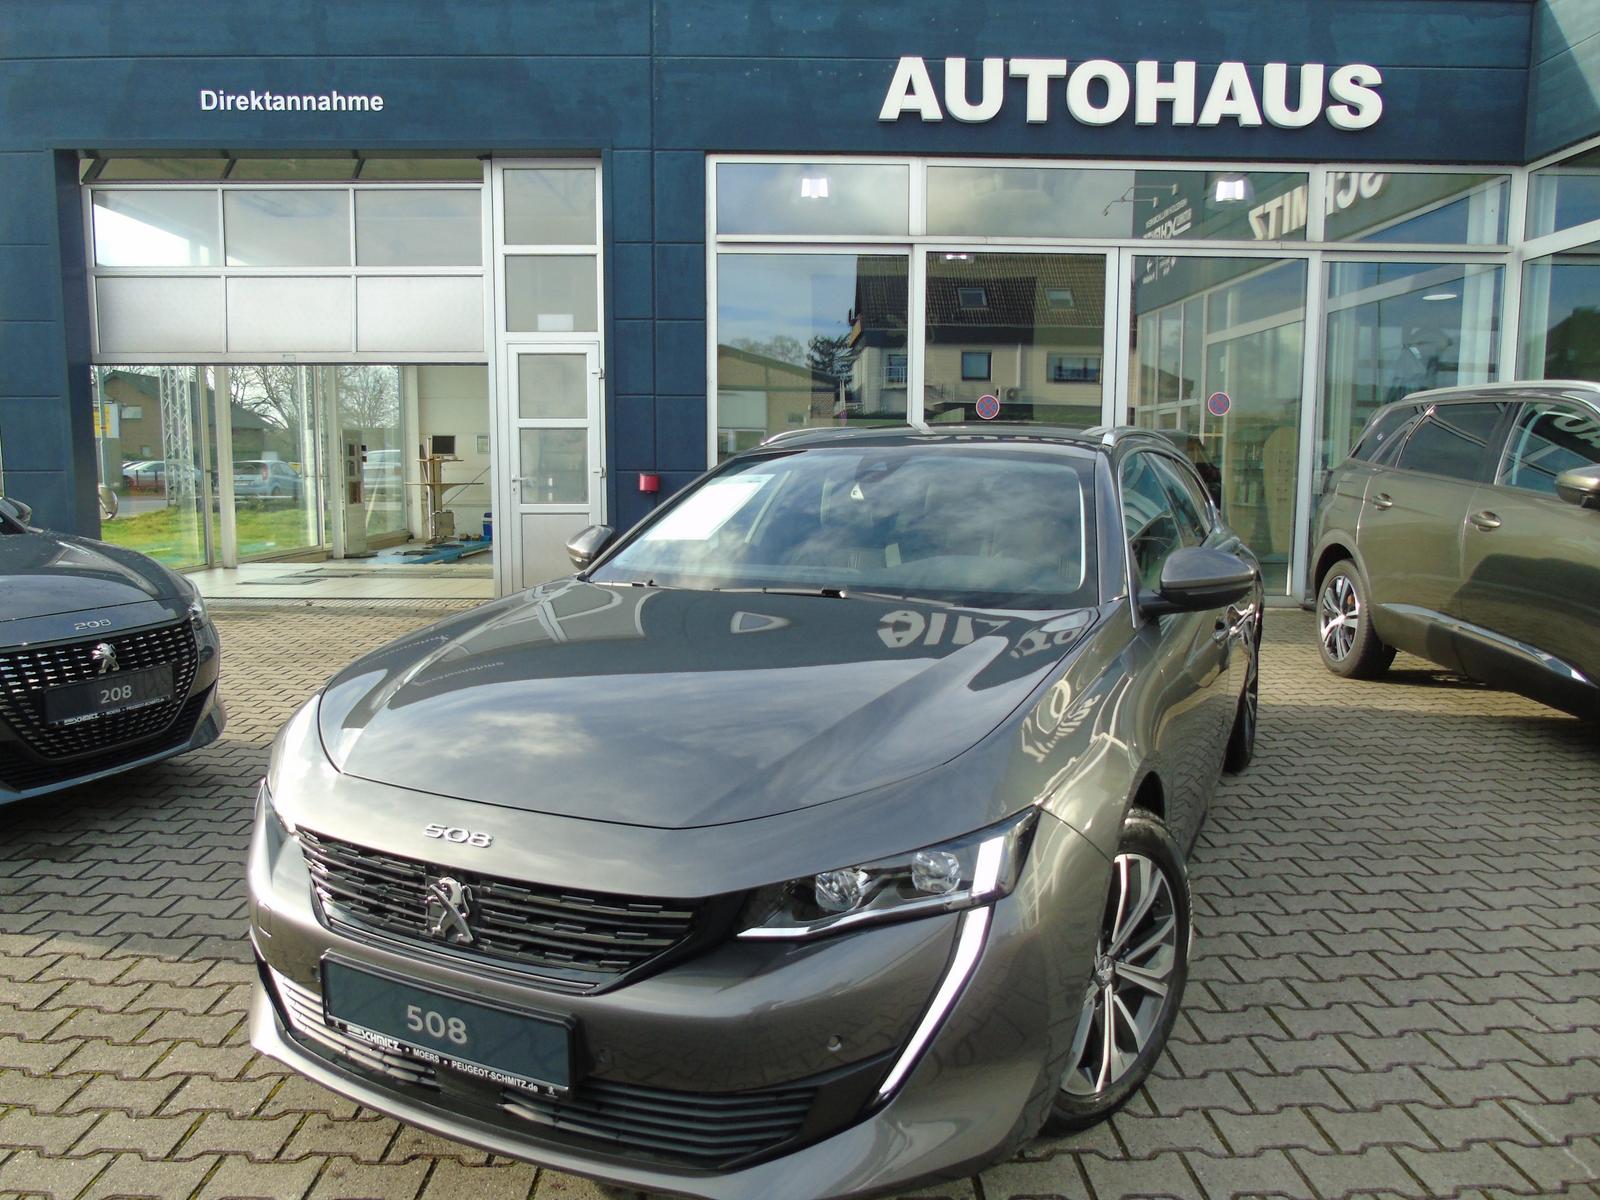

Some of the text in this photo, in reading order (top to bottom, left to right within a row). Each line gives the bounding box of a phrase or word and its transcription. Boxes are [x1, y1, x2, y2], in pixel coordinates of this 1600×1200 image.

[200, 89, 384, 112] Direktannahme
[878, 56, 1383, 131] AUTOHAUS
[74, 619, 111, 630] 208
[100, 685, 132, 704] 208
[423, 823, 493, 848] 508
[406, 1005, 467, 1044] 508
[412, 1047, 440, 1063] MOERS
[451, 1060, 539, 1092] PEUGEOT-SCHMITZ.de
